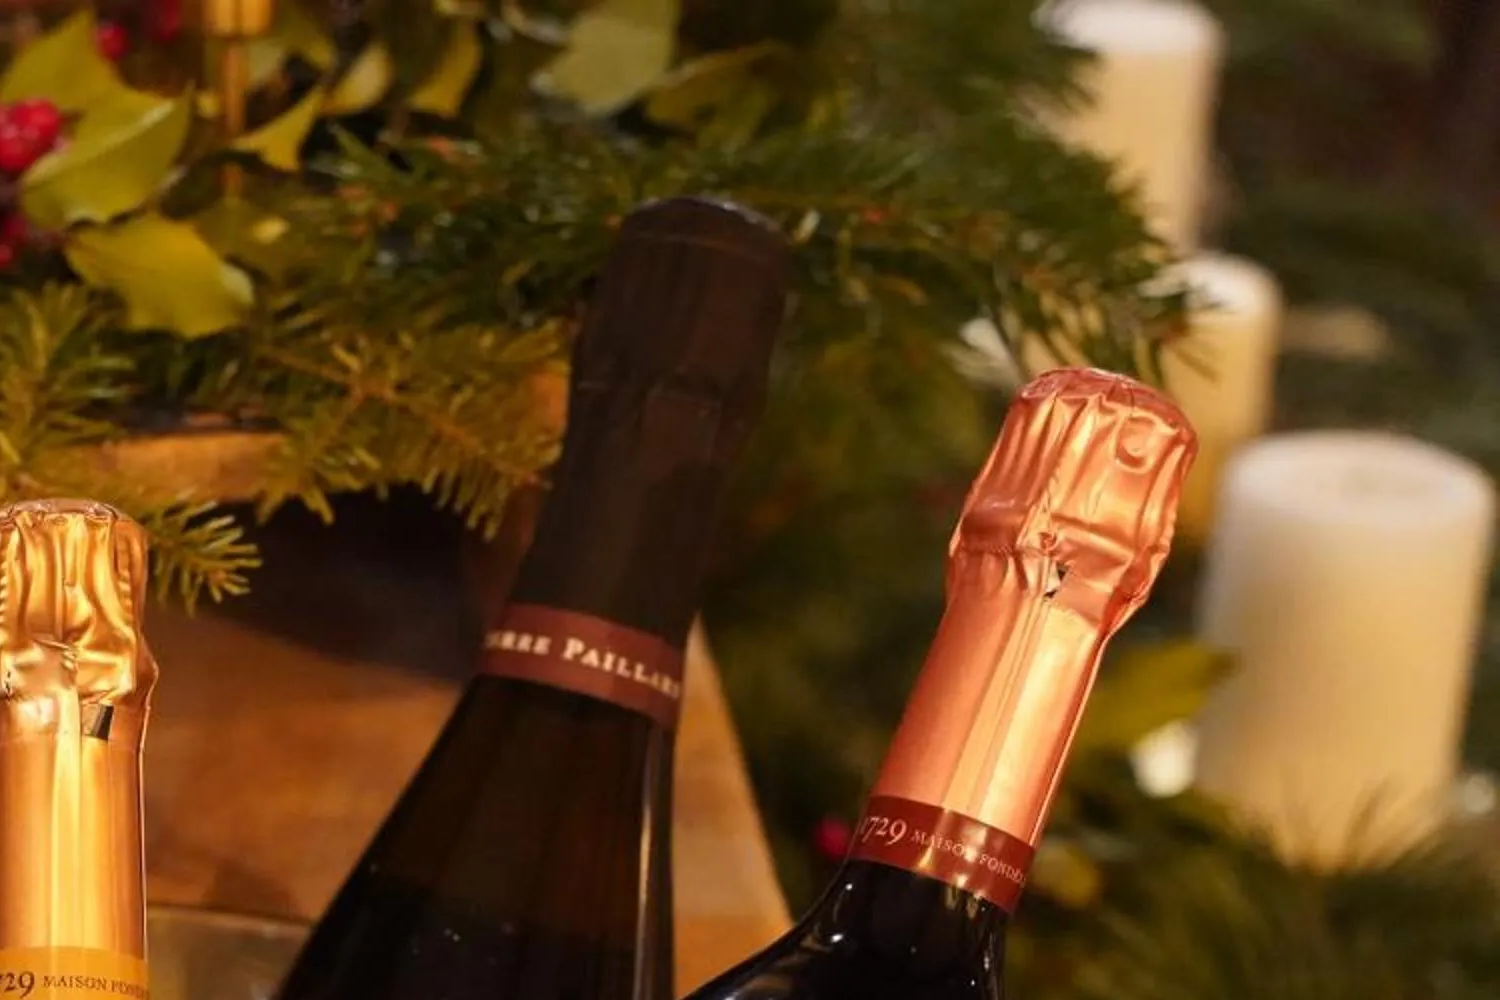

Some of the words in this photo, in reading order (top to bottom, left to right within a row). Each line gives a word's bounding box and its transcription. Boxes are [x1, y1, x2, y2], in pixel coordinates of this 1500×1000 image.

[859, 816, 907, 846] 1729
[910, 831, 968, 858] MAISO
[43, 974, 107, 993] MAISON
